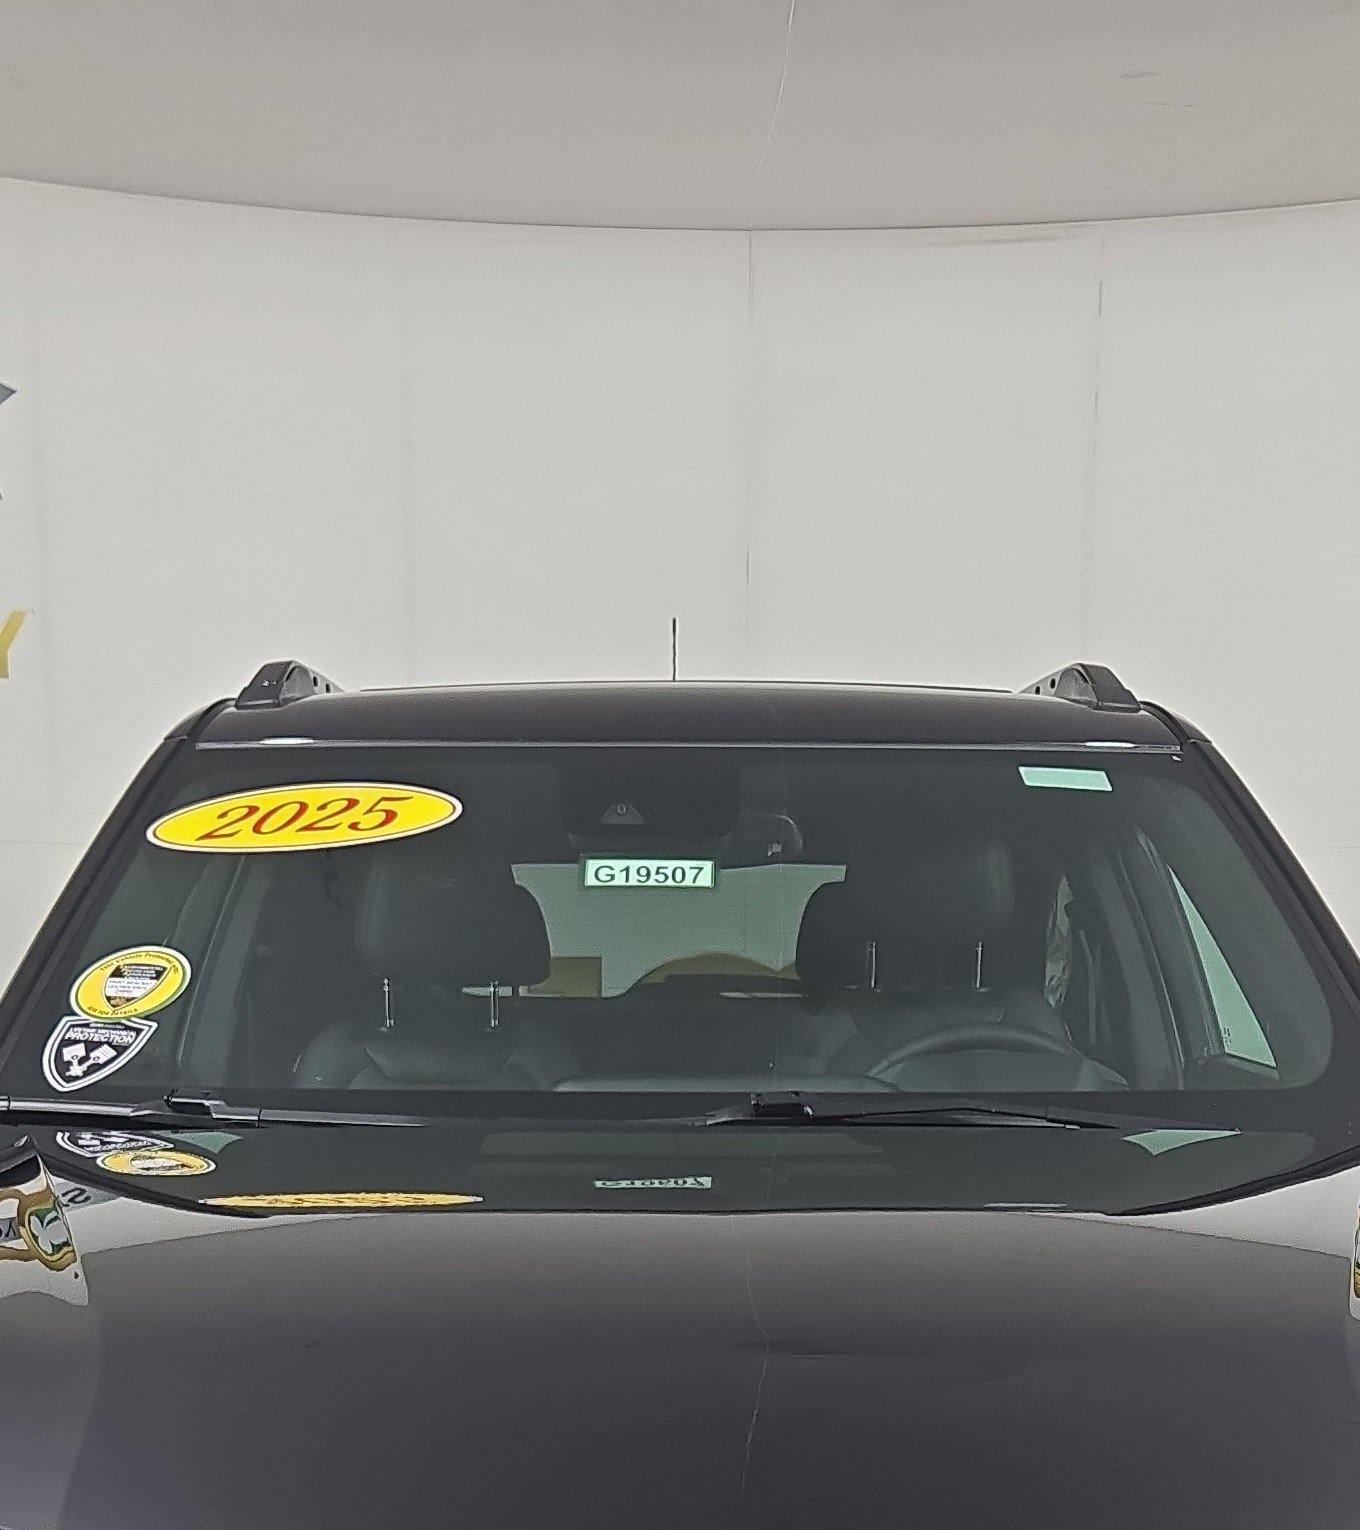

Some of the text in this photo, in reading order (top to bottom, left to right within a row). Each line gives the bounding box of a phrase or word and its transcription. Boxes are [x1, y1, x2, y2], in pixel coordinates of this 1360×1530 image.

[195, 796, 414, 841] 2025
[594, 865, 704, 884] G19507
[65, 1031, 136, 1045] PROTECTION
